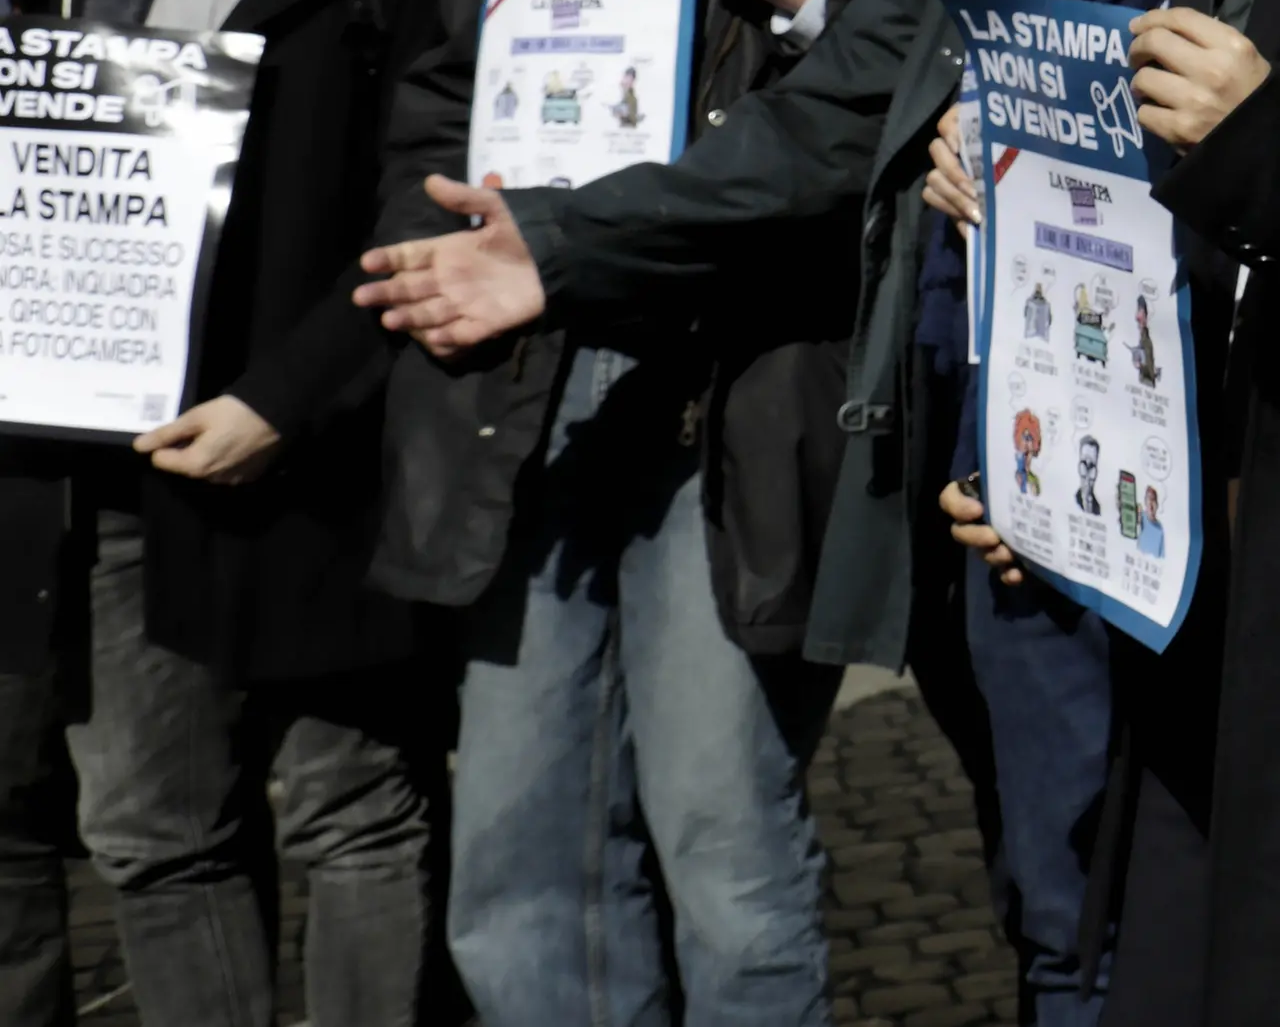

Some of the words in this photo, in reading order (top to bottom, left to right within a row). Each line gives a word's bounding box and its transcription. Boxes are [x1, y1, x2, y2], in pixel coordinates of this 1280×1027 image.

[20, 28, 207, 70] STAMPA
[960, 9, 1011, 44] LA
[1012, 12, 1129, 68] STAMPA
[0, 58, 46, 87] ON
[51, 61, 98, 90] SI
[977, 48, 1037, 93] NON
[1039, 62, 1067, 101] SI
[0, 90, 127, 123] VENDE
[987, 91, 1099, 151] SVENDE
[13, 141, 153, 181] VENDITA
[38, 188, 169, 227] STAMPA
[59, 235, 184, 268] SUCCESSO
[62, 268, 177, 299] INQUADRA
[10, 298, 104, 329] QRCODE
[109, 304, 157, 331] CON
[11, 331, 163, 366] FOTOCAMERA
